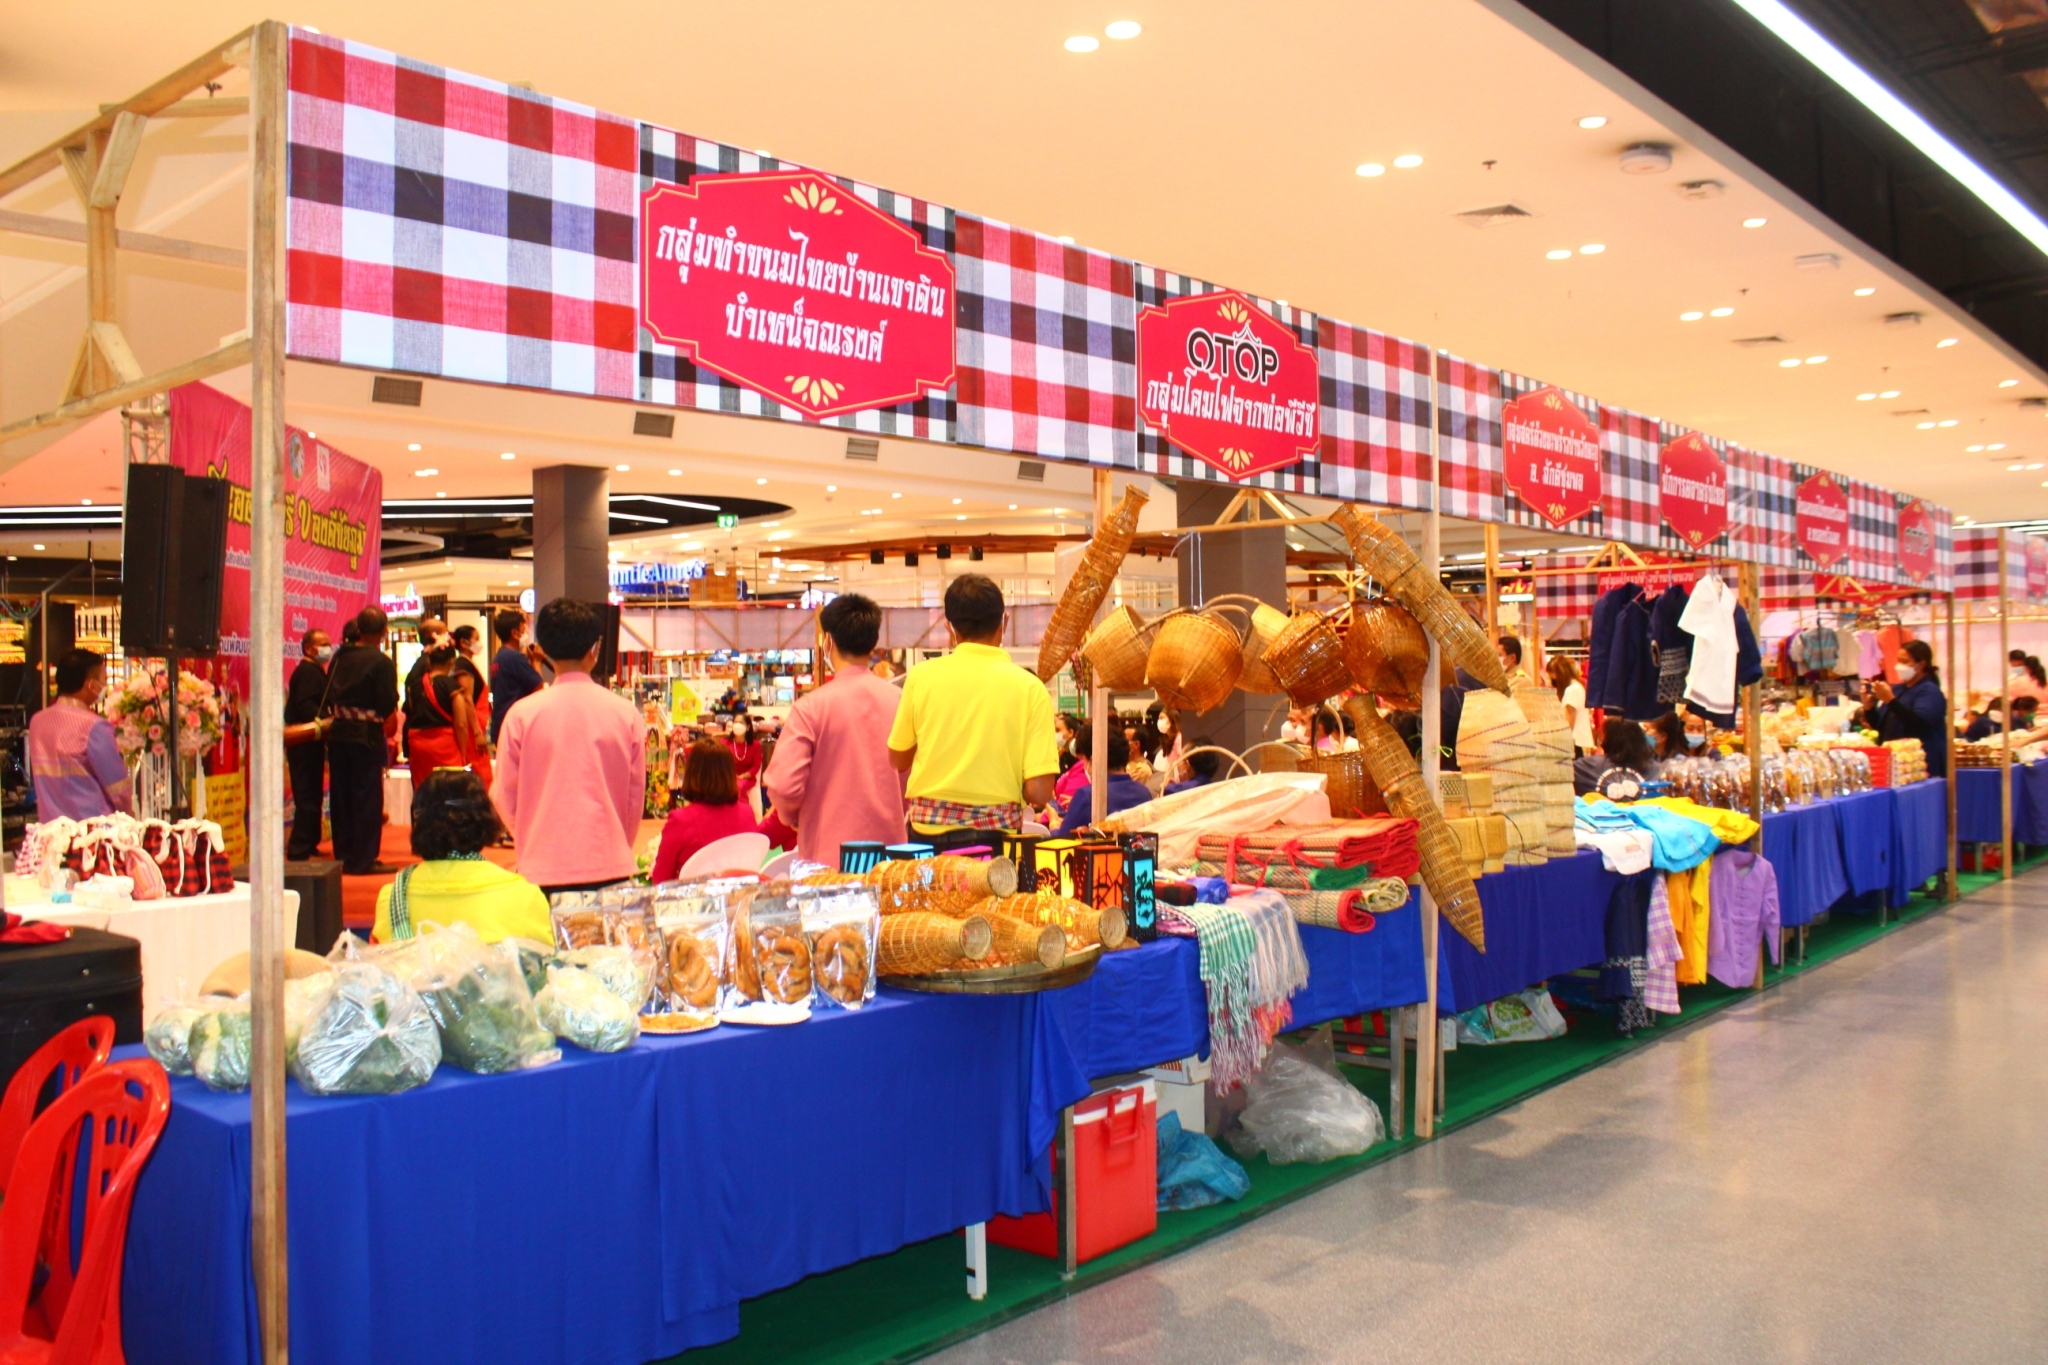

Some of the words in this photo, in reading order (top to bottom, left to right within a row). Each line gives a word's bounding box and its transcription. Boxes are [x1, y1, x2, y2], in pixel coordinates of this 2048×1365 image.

[655, 217, 946, 318] กลุ่มทำขนมไทยบ้านเขาดิน
[725, 290, 888, 363] บำเหน็จณรงค์
[1187, 326, 1279, 386] OTOP
[1146, 367, 1316, 438] กลุ่มโคมไฟจากท่อพีวีซี
